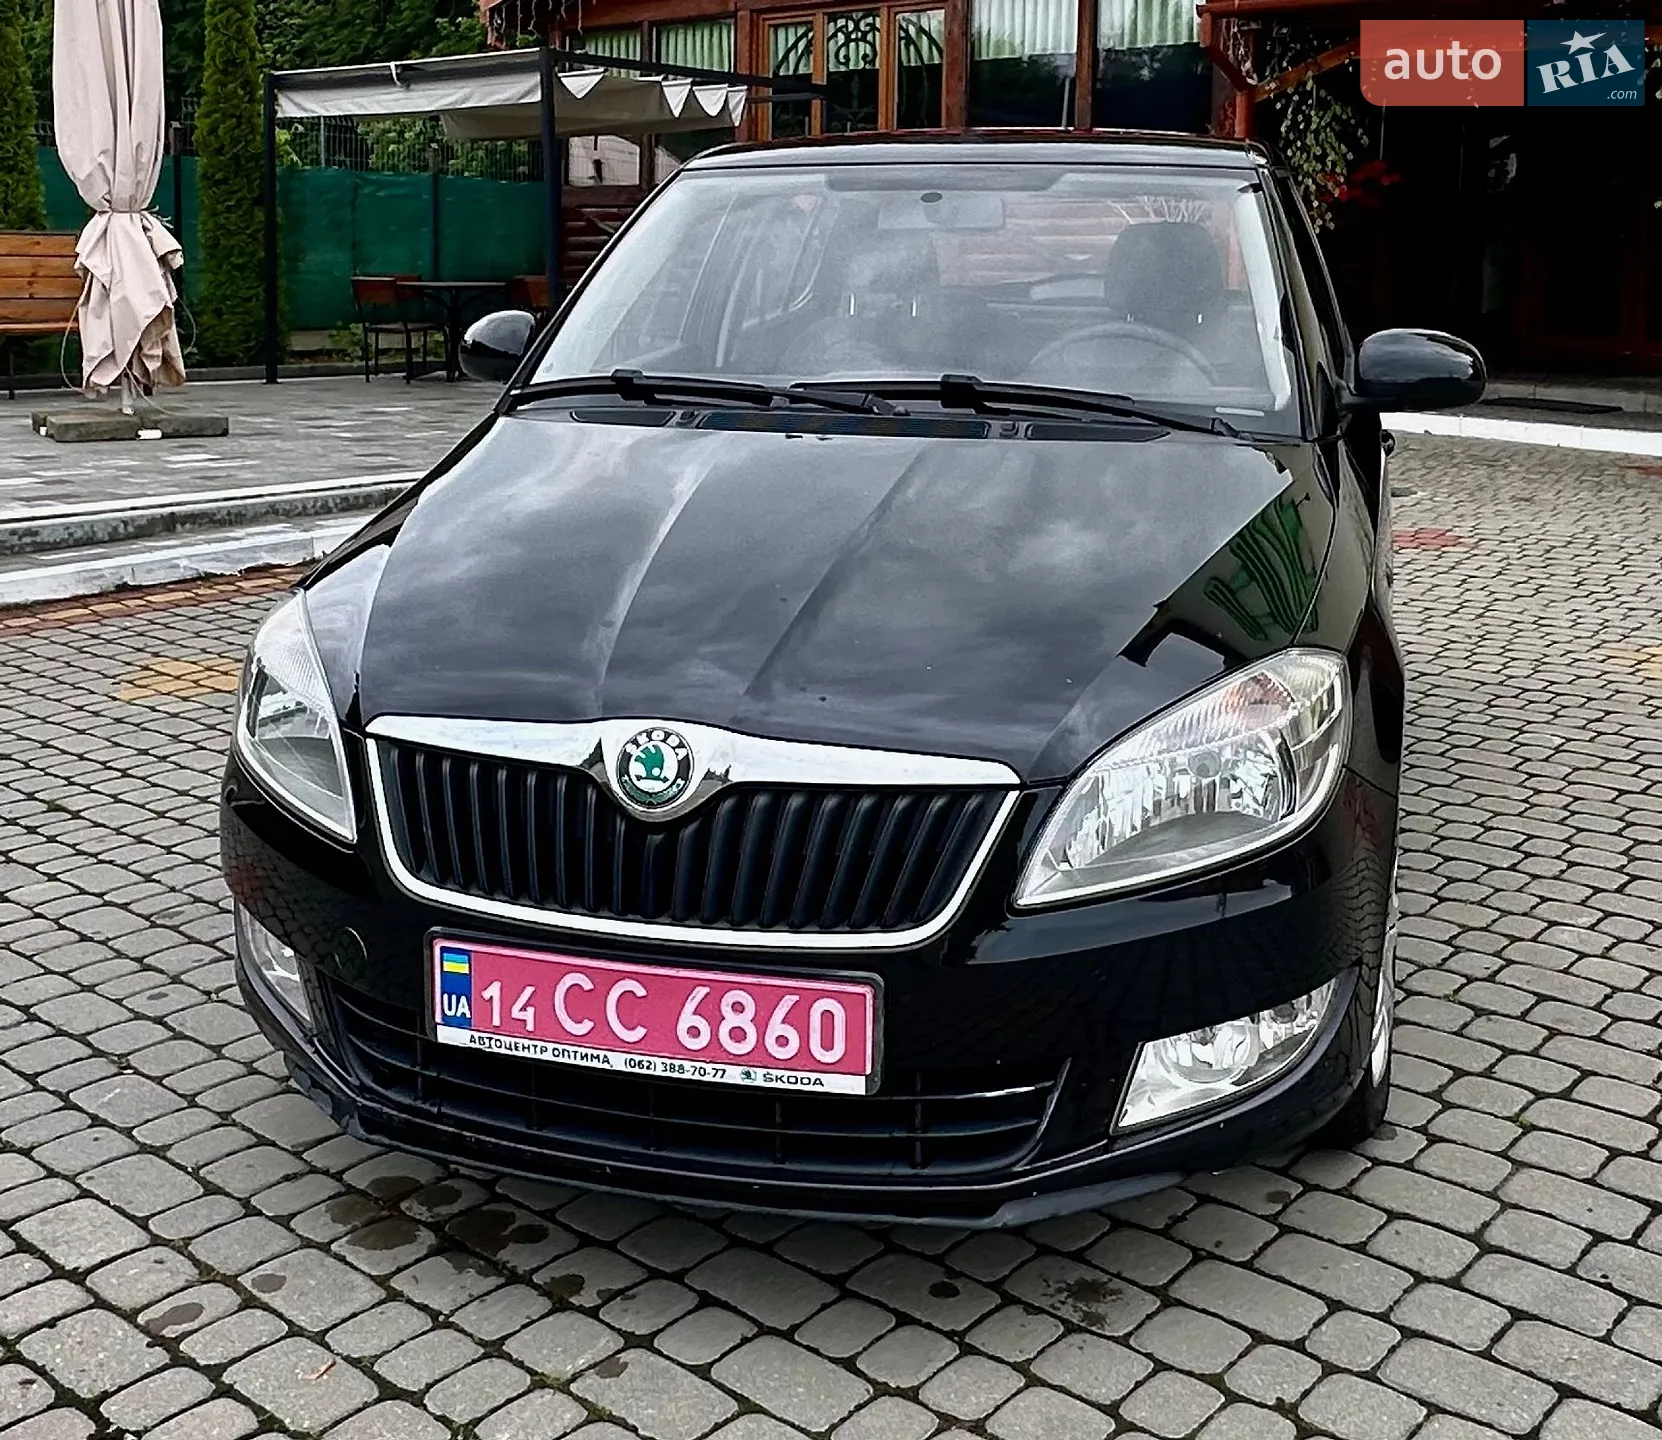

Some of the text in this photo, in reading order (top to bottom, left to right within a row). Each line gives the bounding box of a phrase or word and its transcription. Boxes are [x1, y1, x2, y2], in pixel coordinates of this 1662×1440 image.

[443, 993, 471, 1018] UA
[481, 972, 846, 1064] 14 CC 6860
[469, 1034, 548, 1055] АВТОЦЕНТР
[624, 1057, 657, 1073] (062)
